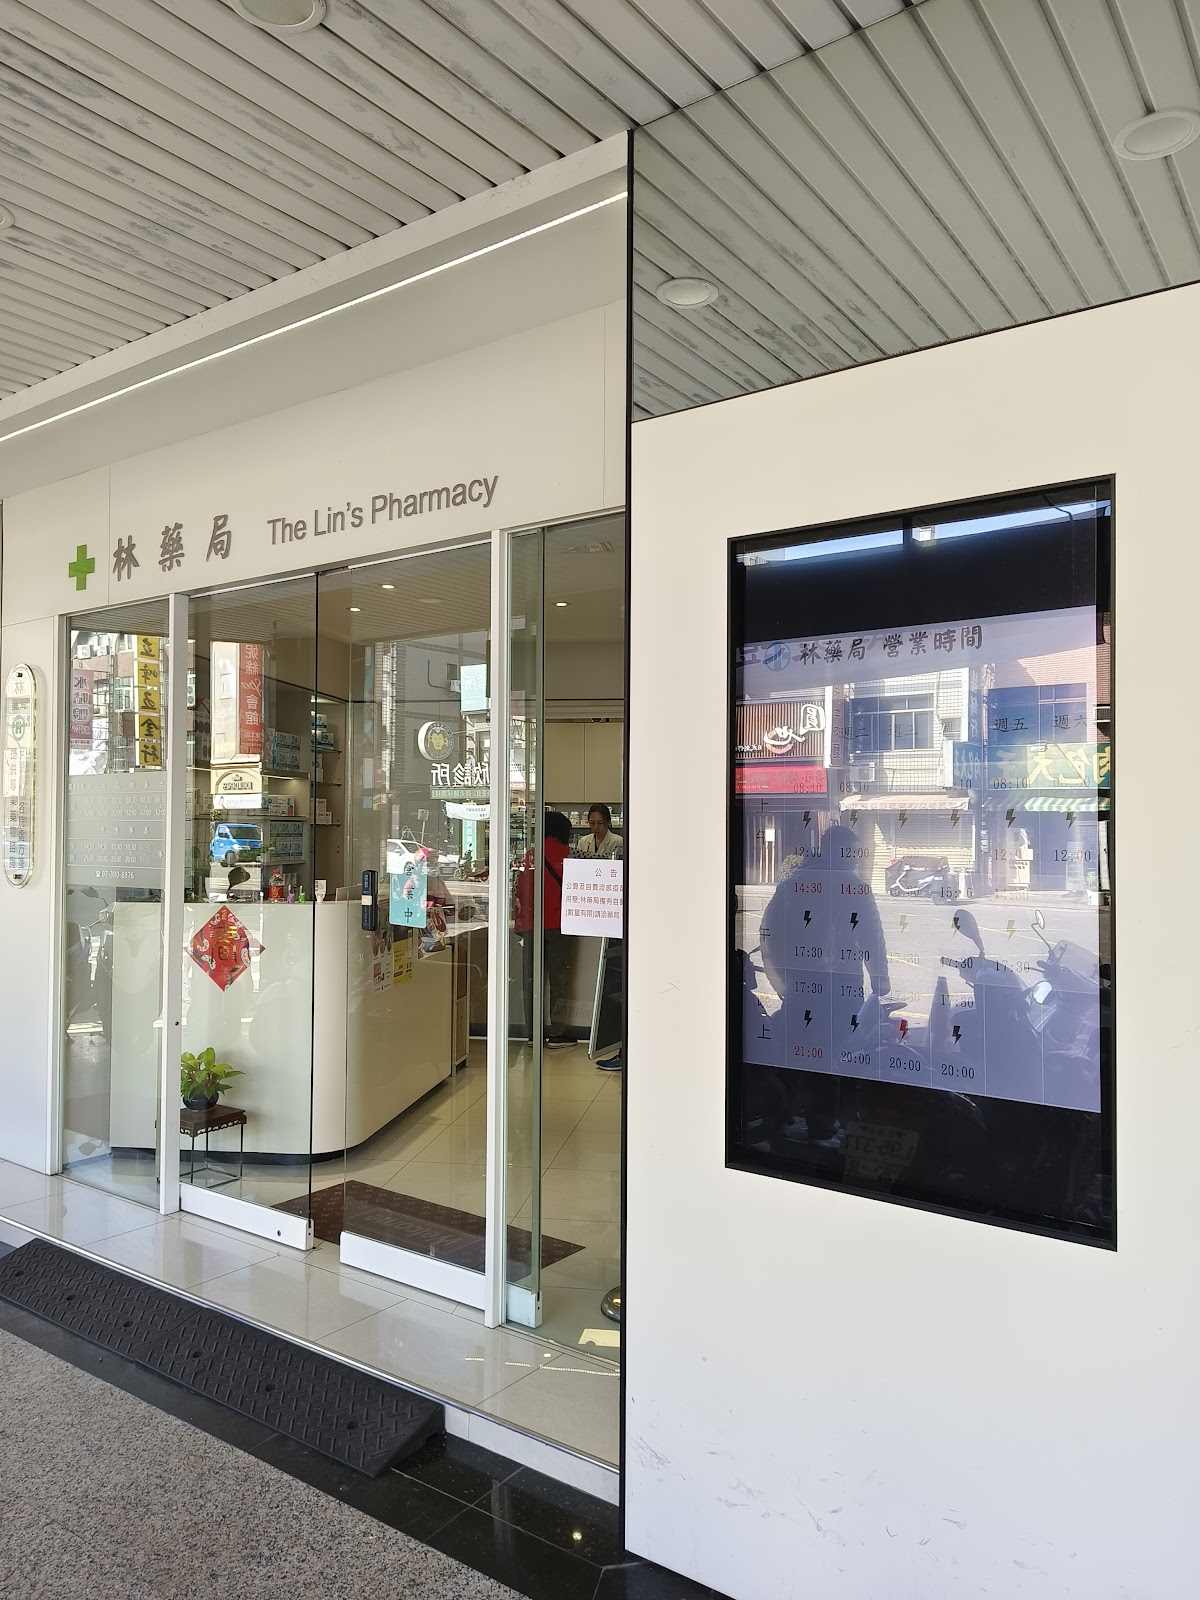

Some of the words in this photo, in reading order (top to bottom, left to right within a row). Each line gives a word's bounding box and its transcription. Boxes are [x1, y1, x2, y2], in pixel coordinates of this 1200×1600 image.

[267, 516, 307, 546] The
[313, 500, 364, 537] Lin's
[371, 475, 499, 524] Pharmacy
[112, 513, 233, 582] 林藥局
[799, 638, 868, 666] 林藥局
[882, 624, 983, 659] 營業時間
[992, 717, 1029, 732] 週五
[1053, 714, 1088, 730] 週六
[793, 846, 823, 858] 12:00
[840, 847, 870, 859] 12:00
[1053, 849, 1092, 863] 12:00
[594, 867, 618, 878] 公告
[793, 882, 823, 894] 14:30
[840, 883, 870, 896] 14:30
[940, 887, 973, 899] 15:0
[794, 946, 823, 959] 17:30
[840, 949, 870, 962] 17:30
[995, 960, 1031, 974] 17:30
[794, 981, 823, 994] 17:30
[941, 994, 974, 1009] 17:30
[794, 1045, 823, 1060] 21:00
[840, 1051, 871, 1065] 20:00
[889, 1056, 921, 1072] 20:00
[941, 1063, 975, 1079] 20:00
